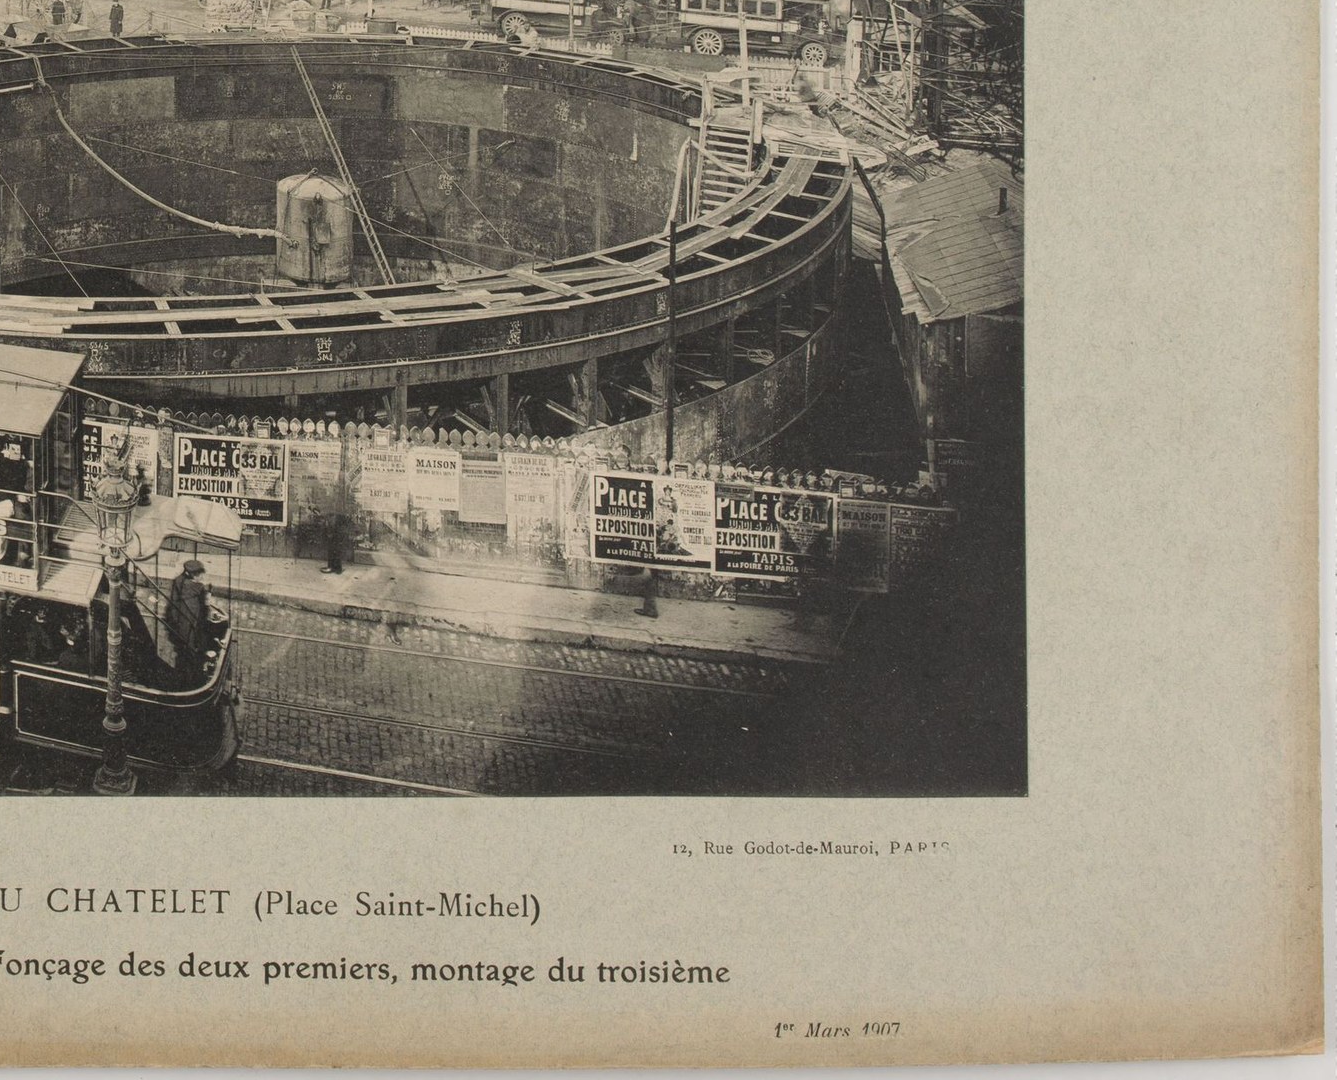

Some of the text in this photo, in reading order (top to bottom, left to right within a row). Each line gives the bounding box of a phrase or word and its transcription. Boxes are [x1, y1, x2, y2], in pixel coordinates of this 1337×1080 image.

[180, 438, 226, 466] PLACE
[232, 450, 240, 468] C
[290, 450, 318, 458] MAISON
[242, 454, 256, 469] 33
[260, 456, 281, 470] BAL
[416, 458, 456, 470] MAISON
[178, 478, 232, 494] EXPOSITION
[596, 476, 646, 508] PLACE
[211, 496, 249, 508] TAPIS
[716, 498, 768, 520] PLACE
[802, 508, 826, 524] BAL
[842, 510, 886, 522] MAISON
[596, 518, 654, 537] EXPOSITION
[716, 532, 776, 550] EXPOSITION
[619, 550, 641, 558] FOIRE
[752, 552, 794, 566] TAPIS
[740, 562, 762, 570] FOIRE
[776, 565, 799, 573] PARIS
[672, 843, 693, 858] 12,
[699, 836, 734, 855] Rue
[743, 840, 879, 857] Godot-de-Mauroi,
[46, 887, 231, 914] CHATELET
[254, 890, 338, 923] (Place
[355, 891, 541, 927] Saint-Michel)
[118, 950, 166, 977] des
[178, 951, 250, 979] deux
[262, 957, 398, 986] premiers,
[410, 961, 536, 987] montage
[547, 956, 586, 983] du
[596, 956, 731, 984] troisième
[804, 1022, 851, 1038] Mars
[862, 1021, 901, 1037] 1907
